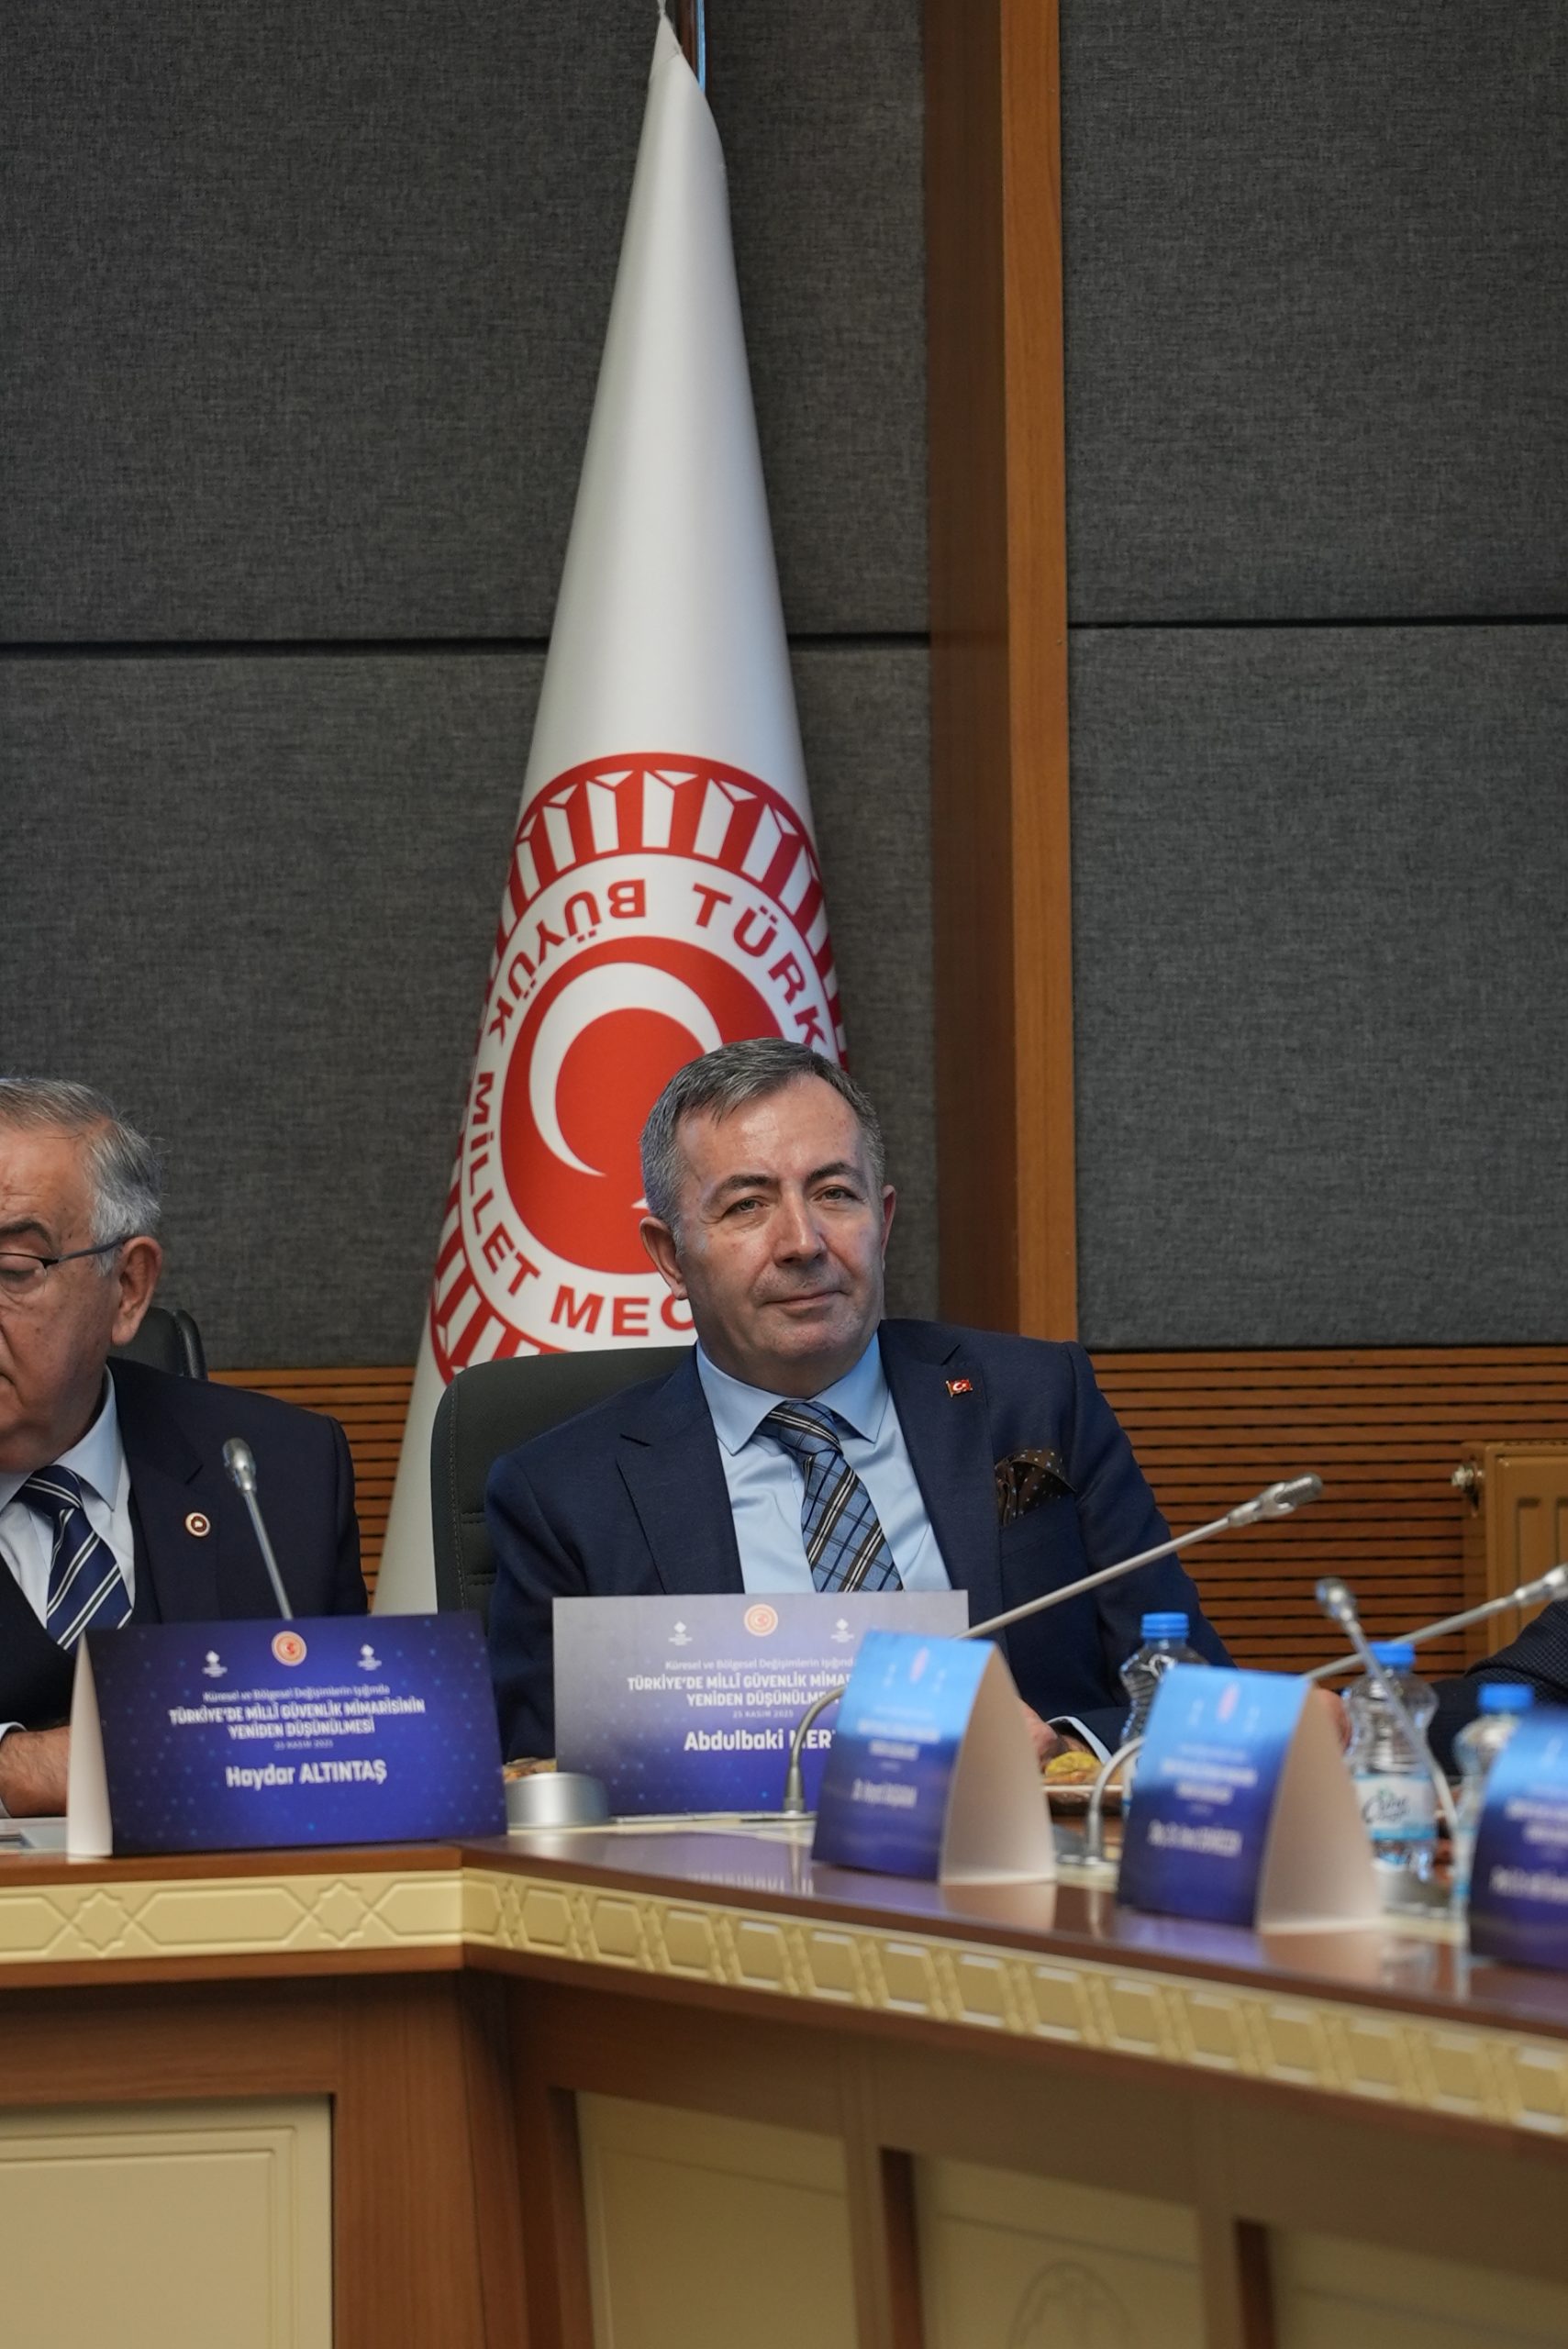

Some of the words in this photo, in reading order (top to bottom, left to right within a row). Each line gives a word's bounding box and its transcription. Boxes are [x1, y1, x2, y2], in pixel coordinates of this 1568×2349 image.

[488, 878, 647, 1046] BÜYÜK
[693, 882, 828, 1049] TÜRK
[469, 1071, 541, 1297] MİLLET
[550, 1284, 697, 1338] MEC
[742, 1670, 806, 1689] GÜVENLİK
[280, 1698, 343, 1720] GÜVENLİK
[343, 1695, 426, 1717] MİMARİSİNİN
[686, 1689, 743, 1707] YENİDEN
[746, 1688, 840, 1708] DÜŞÜNÜLM
[227, 1720, 284, 1741] YENİDEN
[284, 1716, 375, 1739] DÜŞÜNÜLMESİ
[683, 1728, 784, 1752] Abdulbaki
[225, 1762, 295, 1792] Haydar
[298, 1758, 388, 1786] ALTINTAŞ
